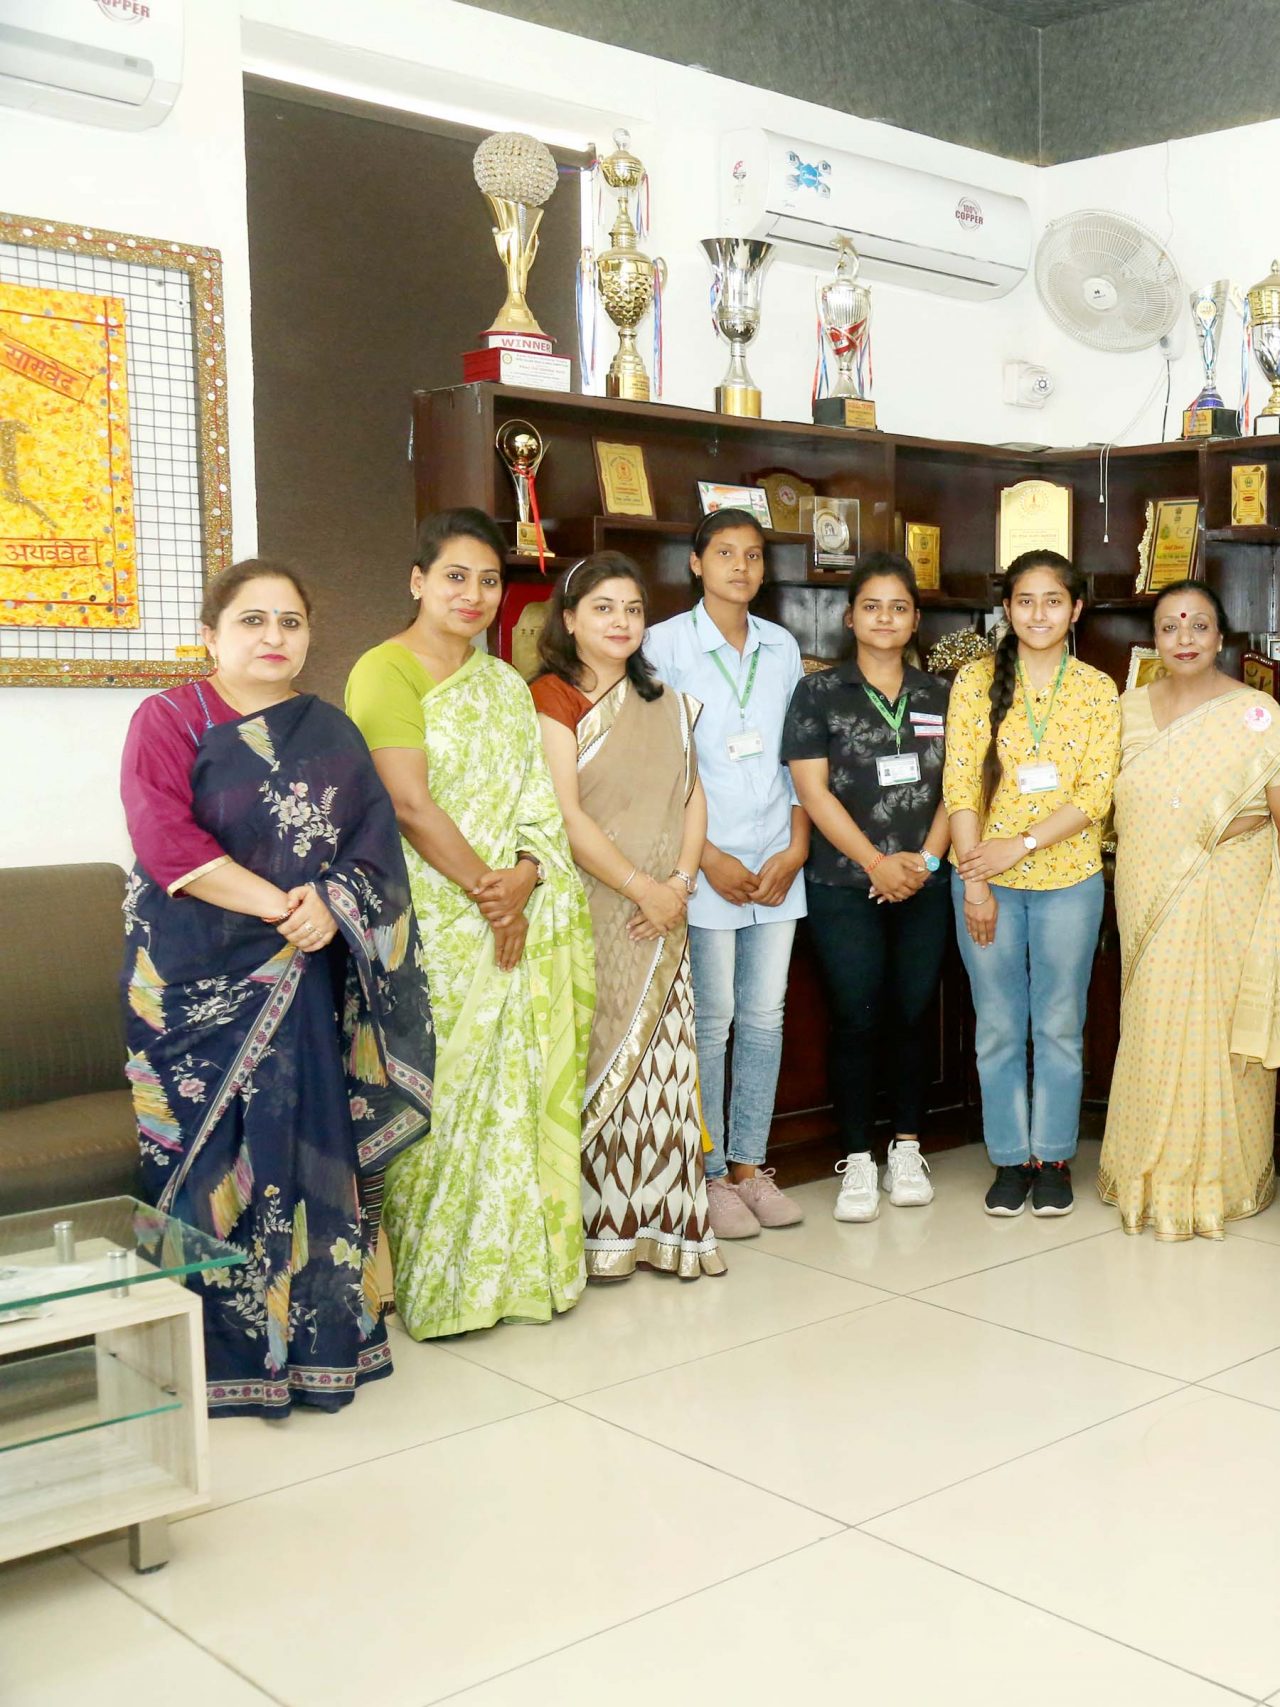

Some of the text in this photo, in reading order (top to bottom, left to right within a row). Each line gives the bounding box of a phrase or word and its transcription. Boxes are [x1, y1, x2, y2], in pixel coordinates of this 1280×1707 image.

[94, 0, 150, 18] PPER
[955, 210, 984, 225] COPPER
[501, 337, 551, 352] WINNER
[4, 343, 79, 393] सामवेद
